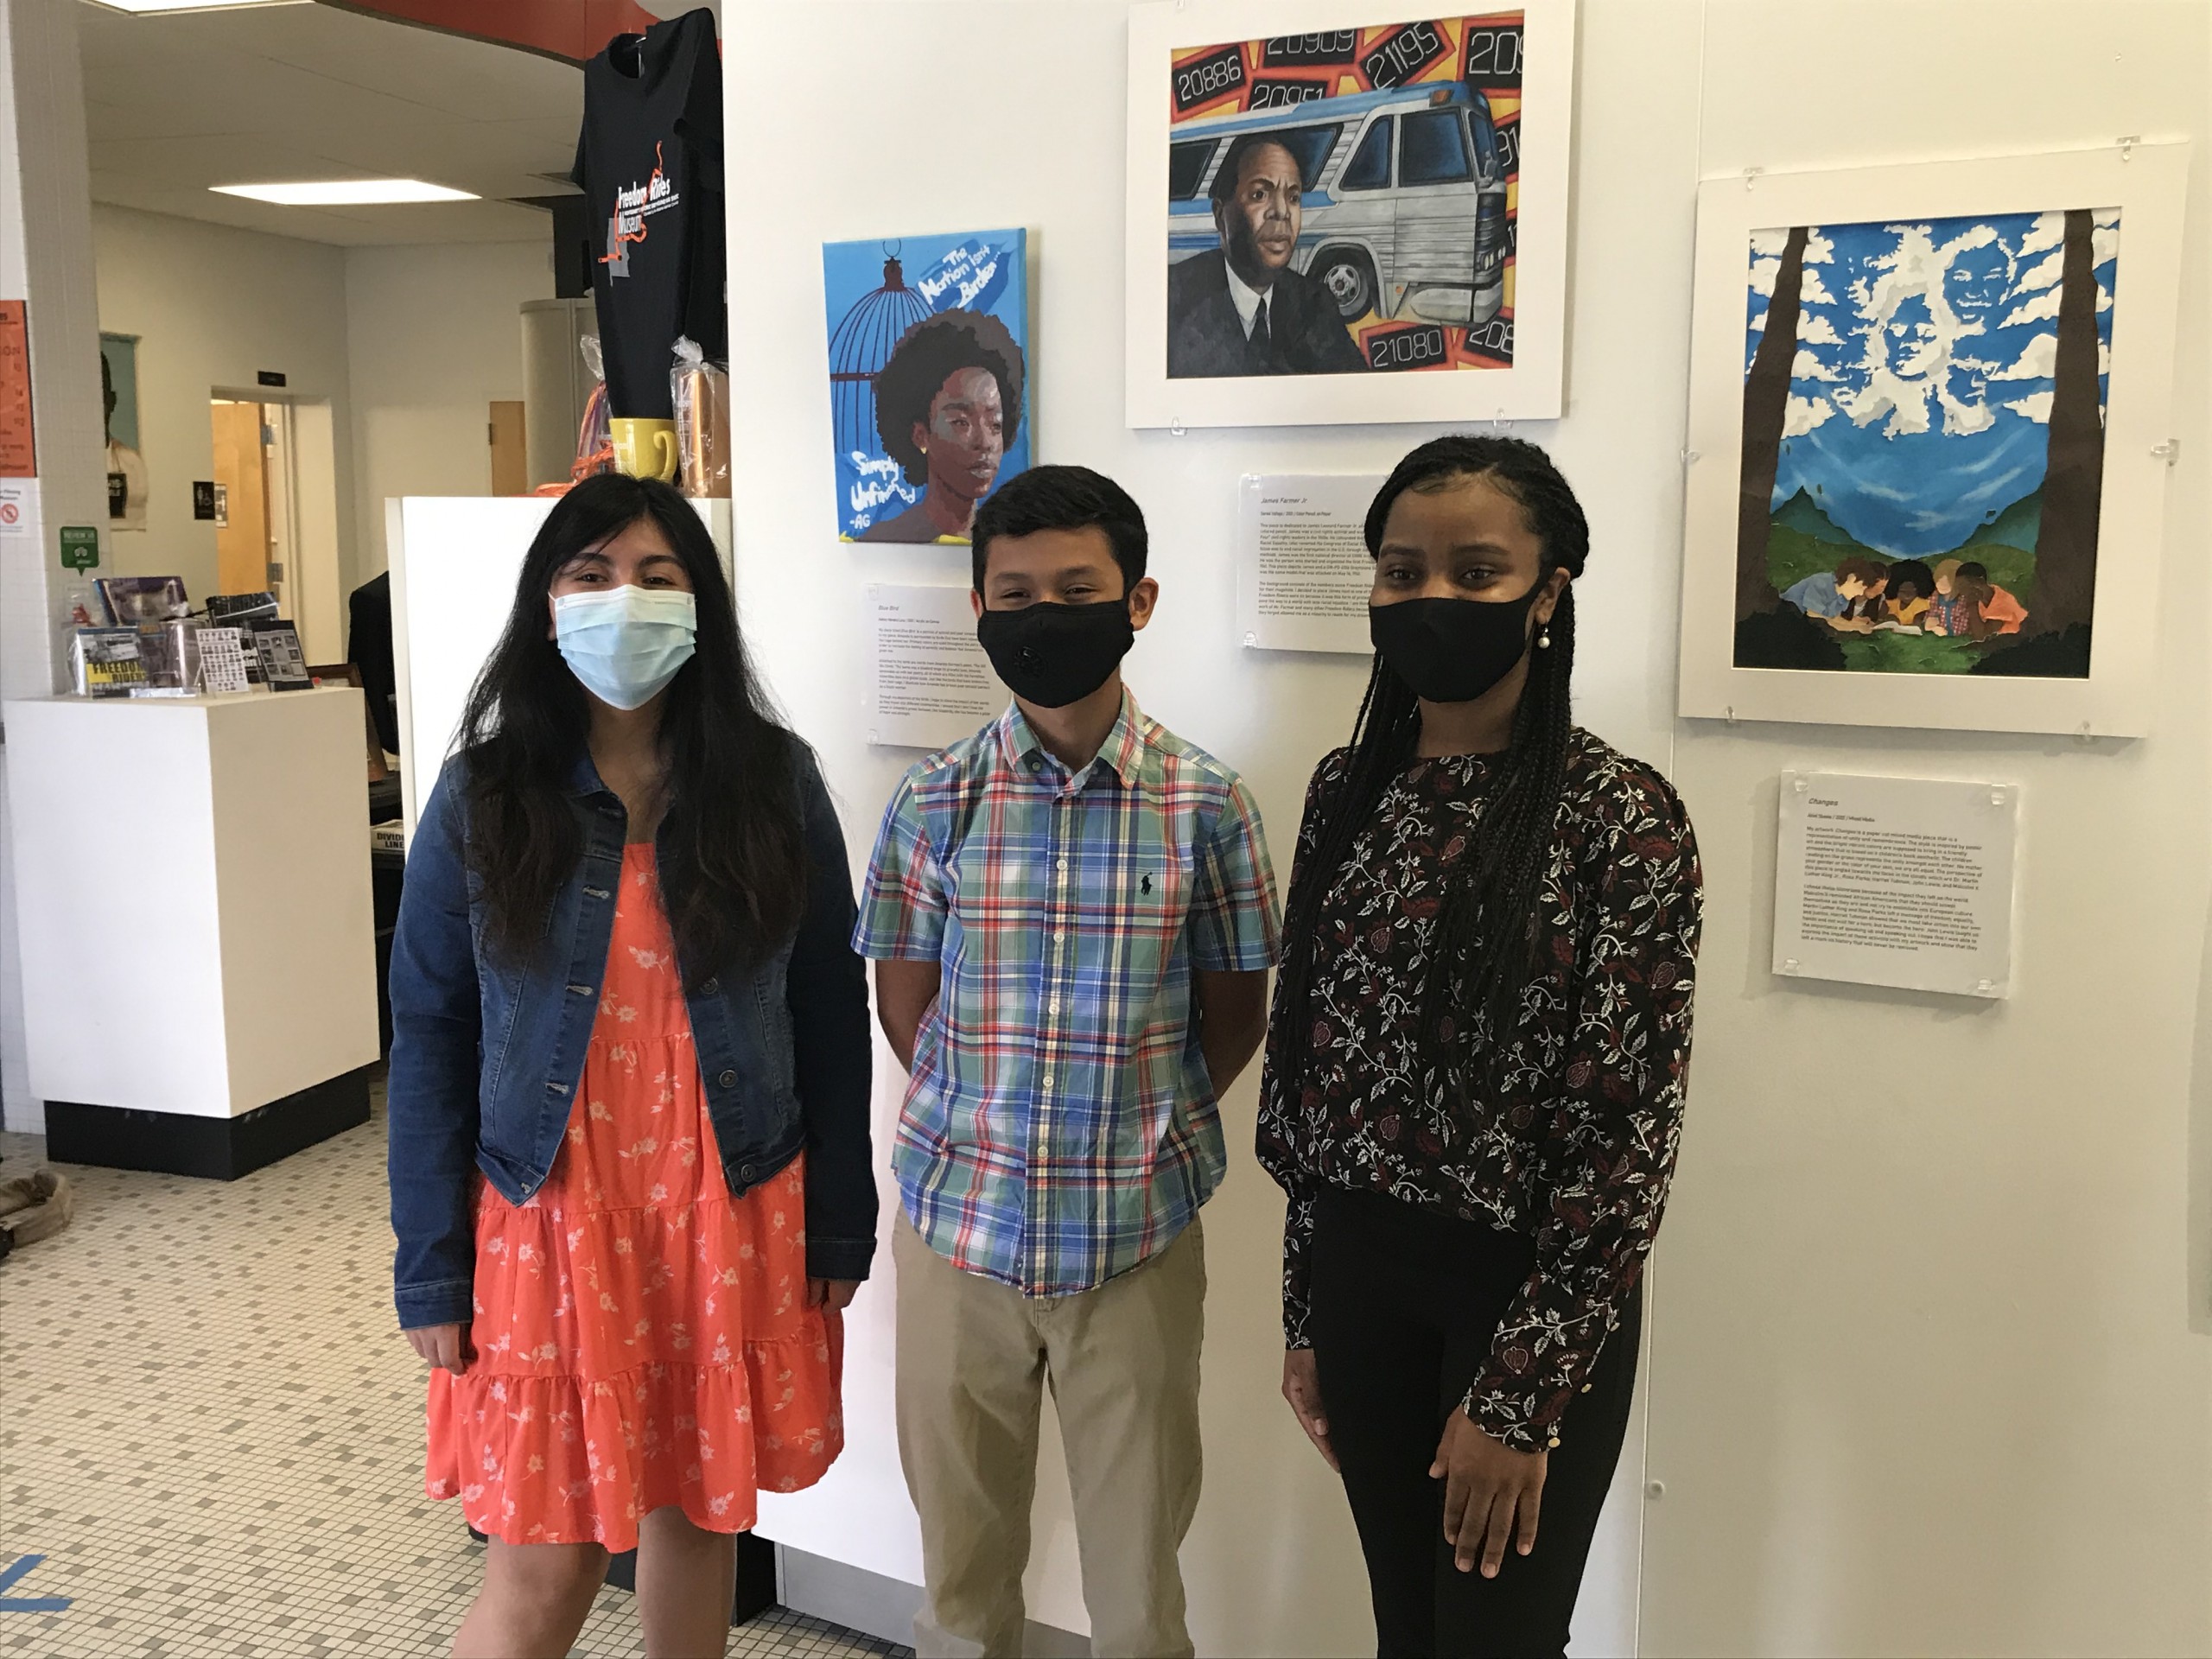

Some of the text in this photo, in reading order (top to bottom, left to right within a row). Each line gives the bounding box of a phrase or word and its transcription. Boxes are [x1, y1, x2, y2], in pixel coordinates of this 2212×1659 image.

[1365, 21, 1439, 90] 21195
[1468, 31, 1523, 75] 20
[1178, 54, 1242, 102] 20886
[942, 247, 968, 266] The
[1371, 328, 1443, 368] 21080
[850, 450, 899, 485] Simply
[1808, 798, 1839, 807] Changes
[376, 832, 405, 841] DIVID
[385, 840, 405, 849] LINE
